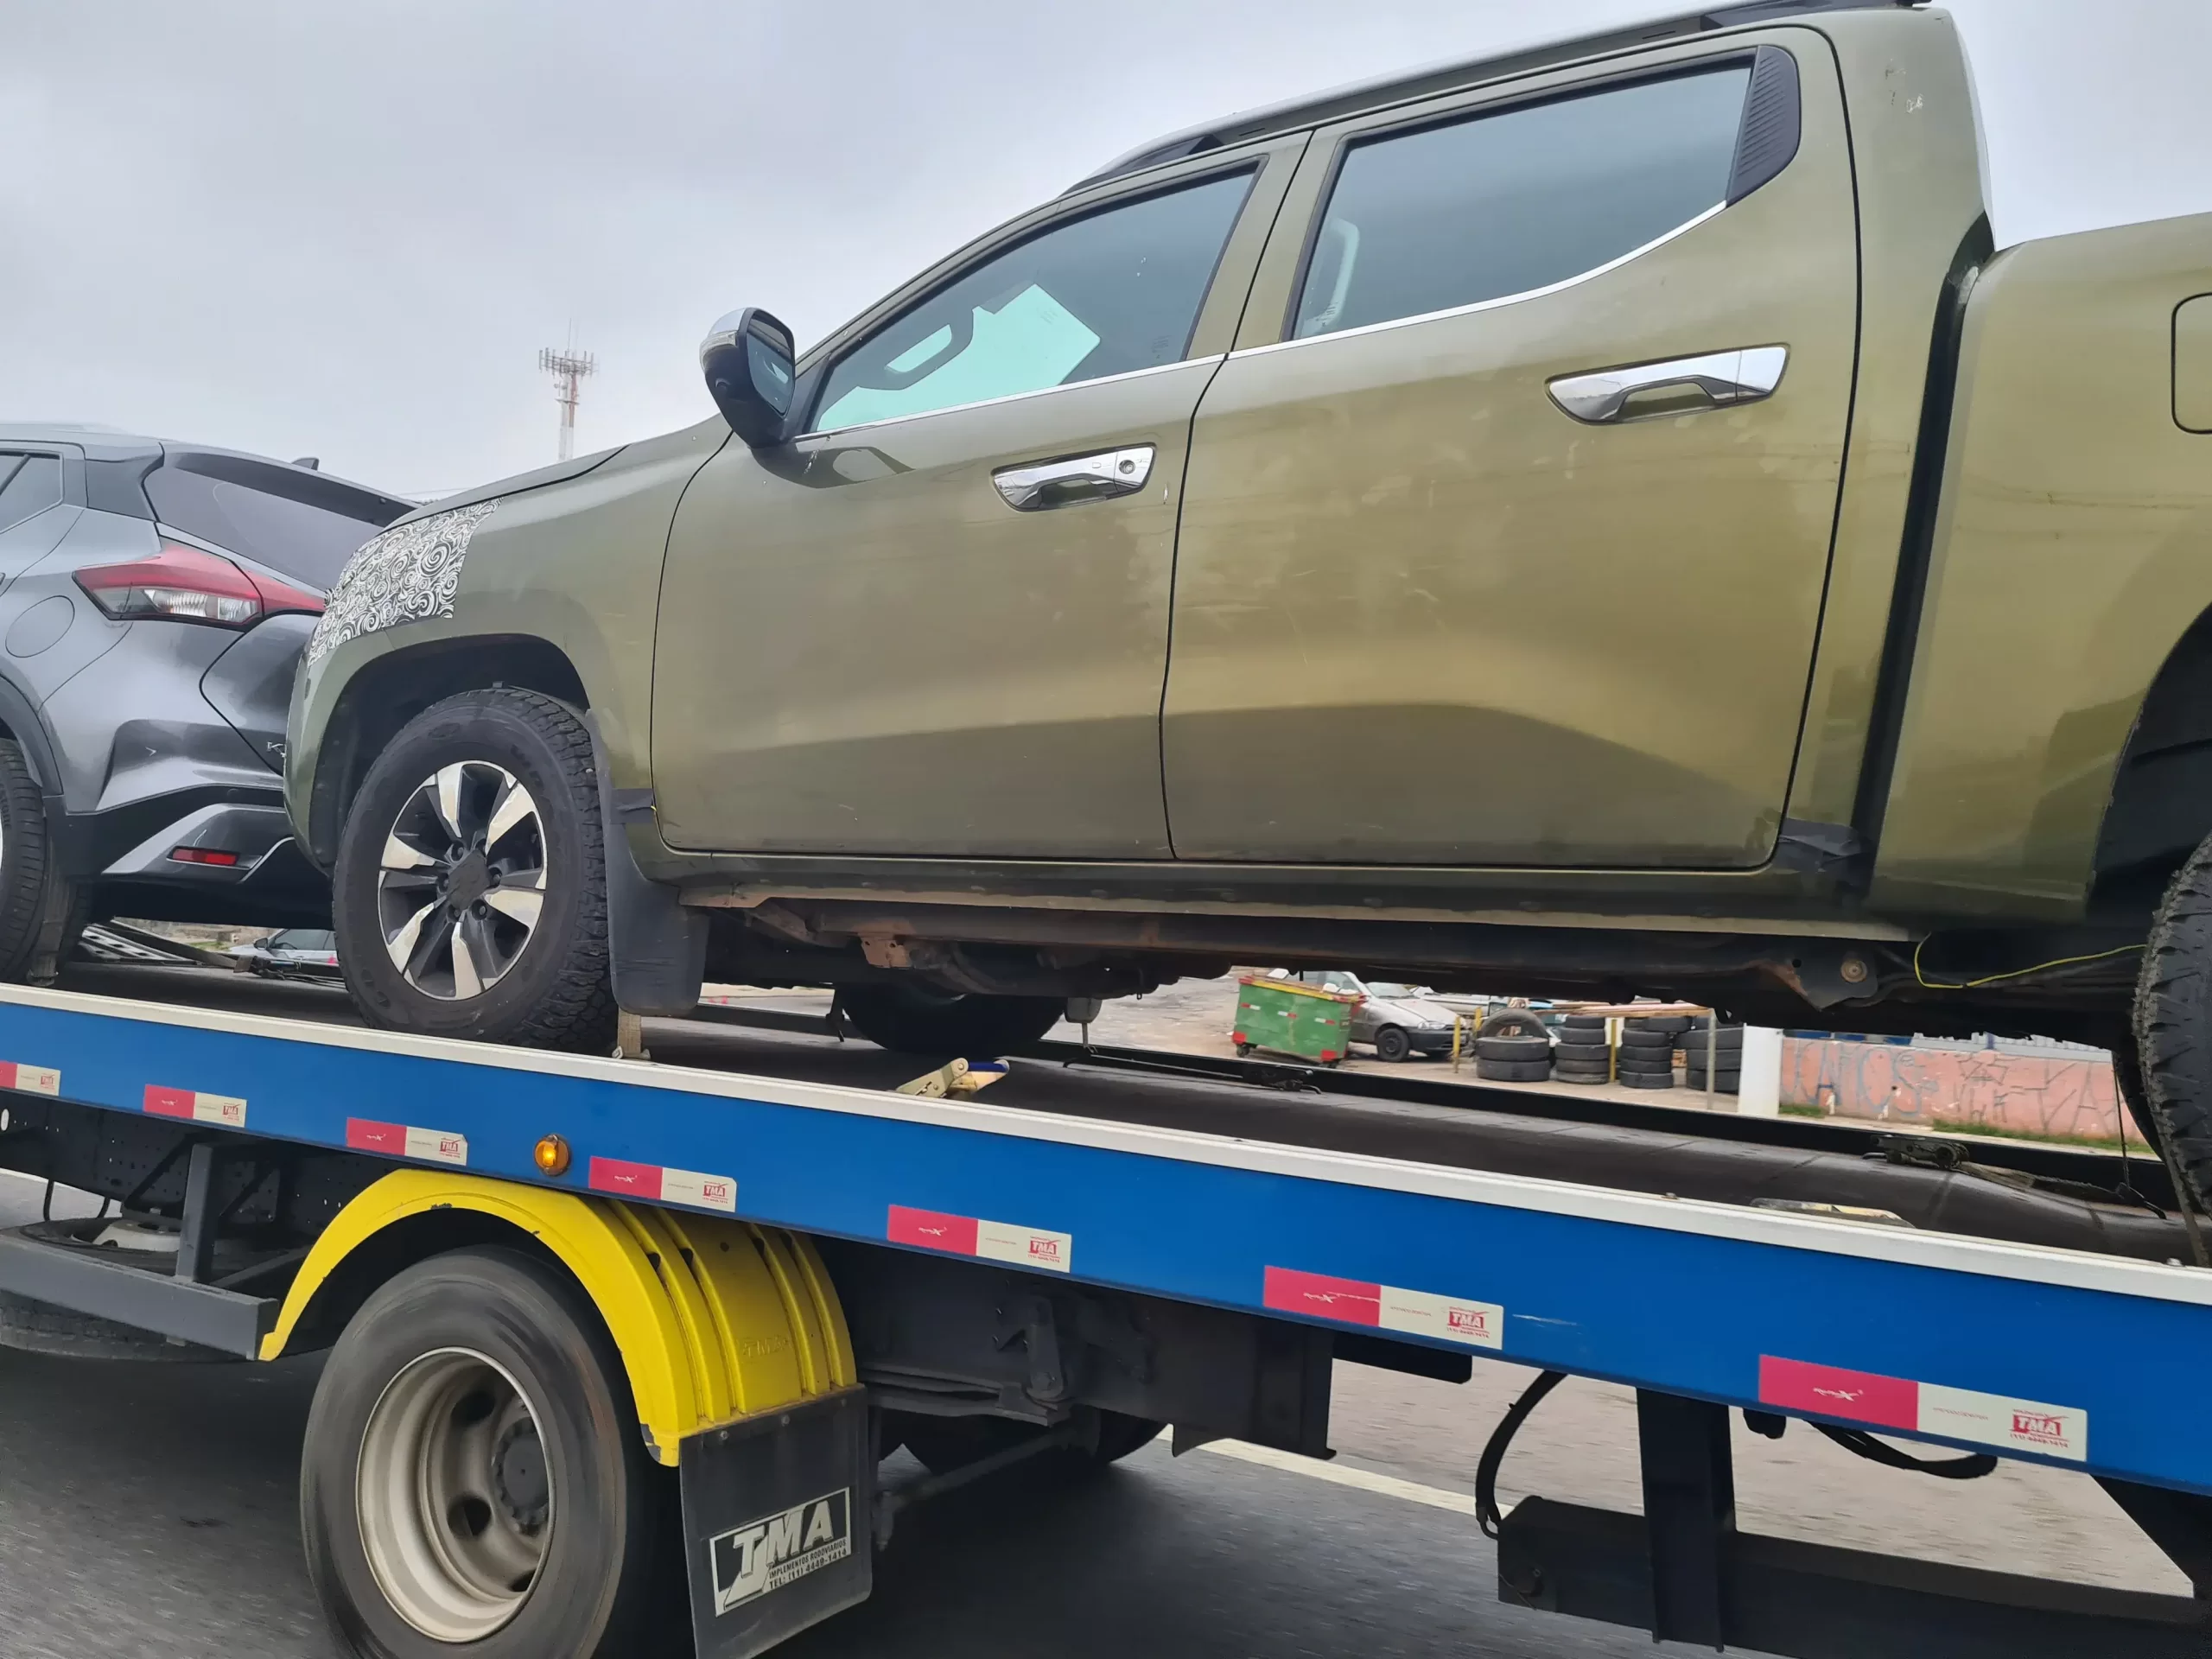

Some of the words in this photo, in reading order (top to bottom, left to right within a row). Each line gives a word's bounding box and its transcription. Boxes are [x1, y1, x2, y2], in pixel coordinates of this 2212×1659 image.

[705, 1185, 724, 1197] TMA
[1033, 1241, 1055, 1255] TMA
[1452, 1313, 1481, 1328] TMA
[2018, 1416, 2057, 1435] TMA
[733, 1500, 834, 1578] TMA
[769, 1554, 809, 1579] IMPLEMENTOS
[770, 1576, 785, 1589] TEL:
[788, 1567, 804, 1580] (11)
[805, 1548, 847, 1572] 4449-1414
